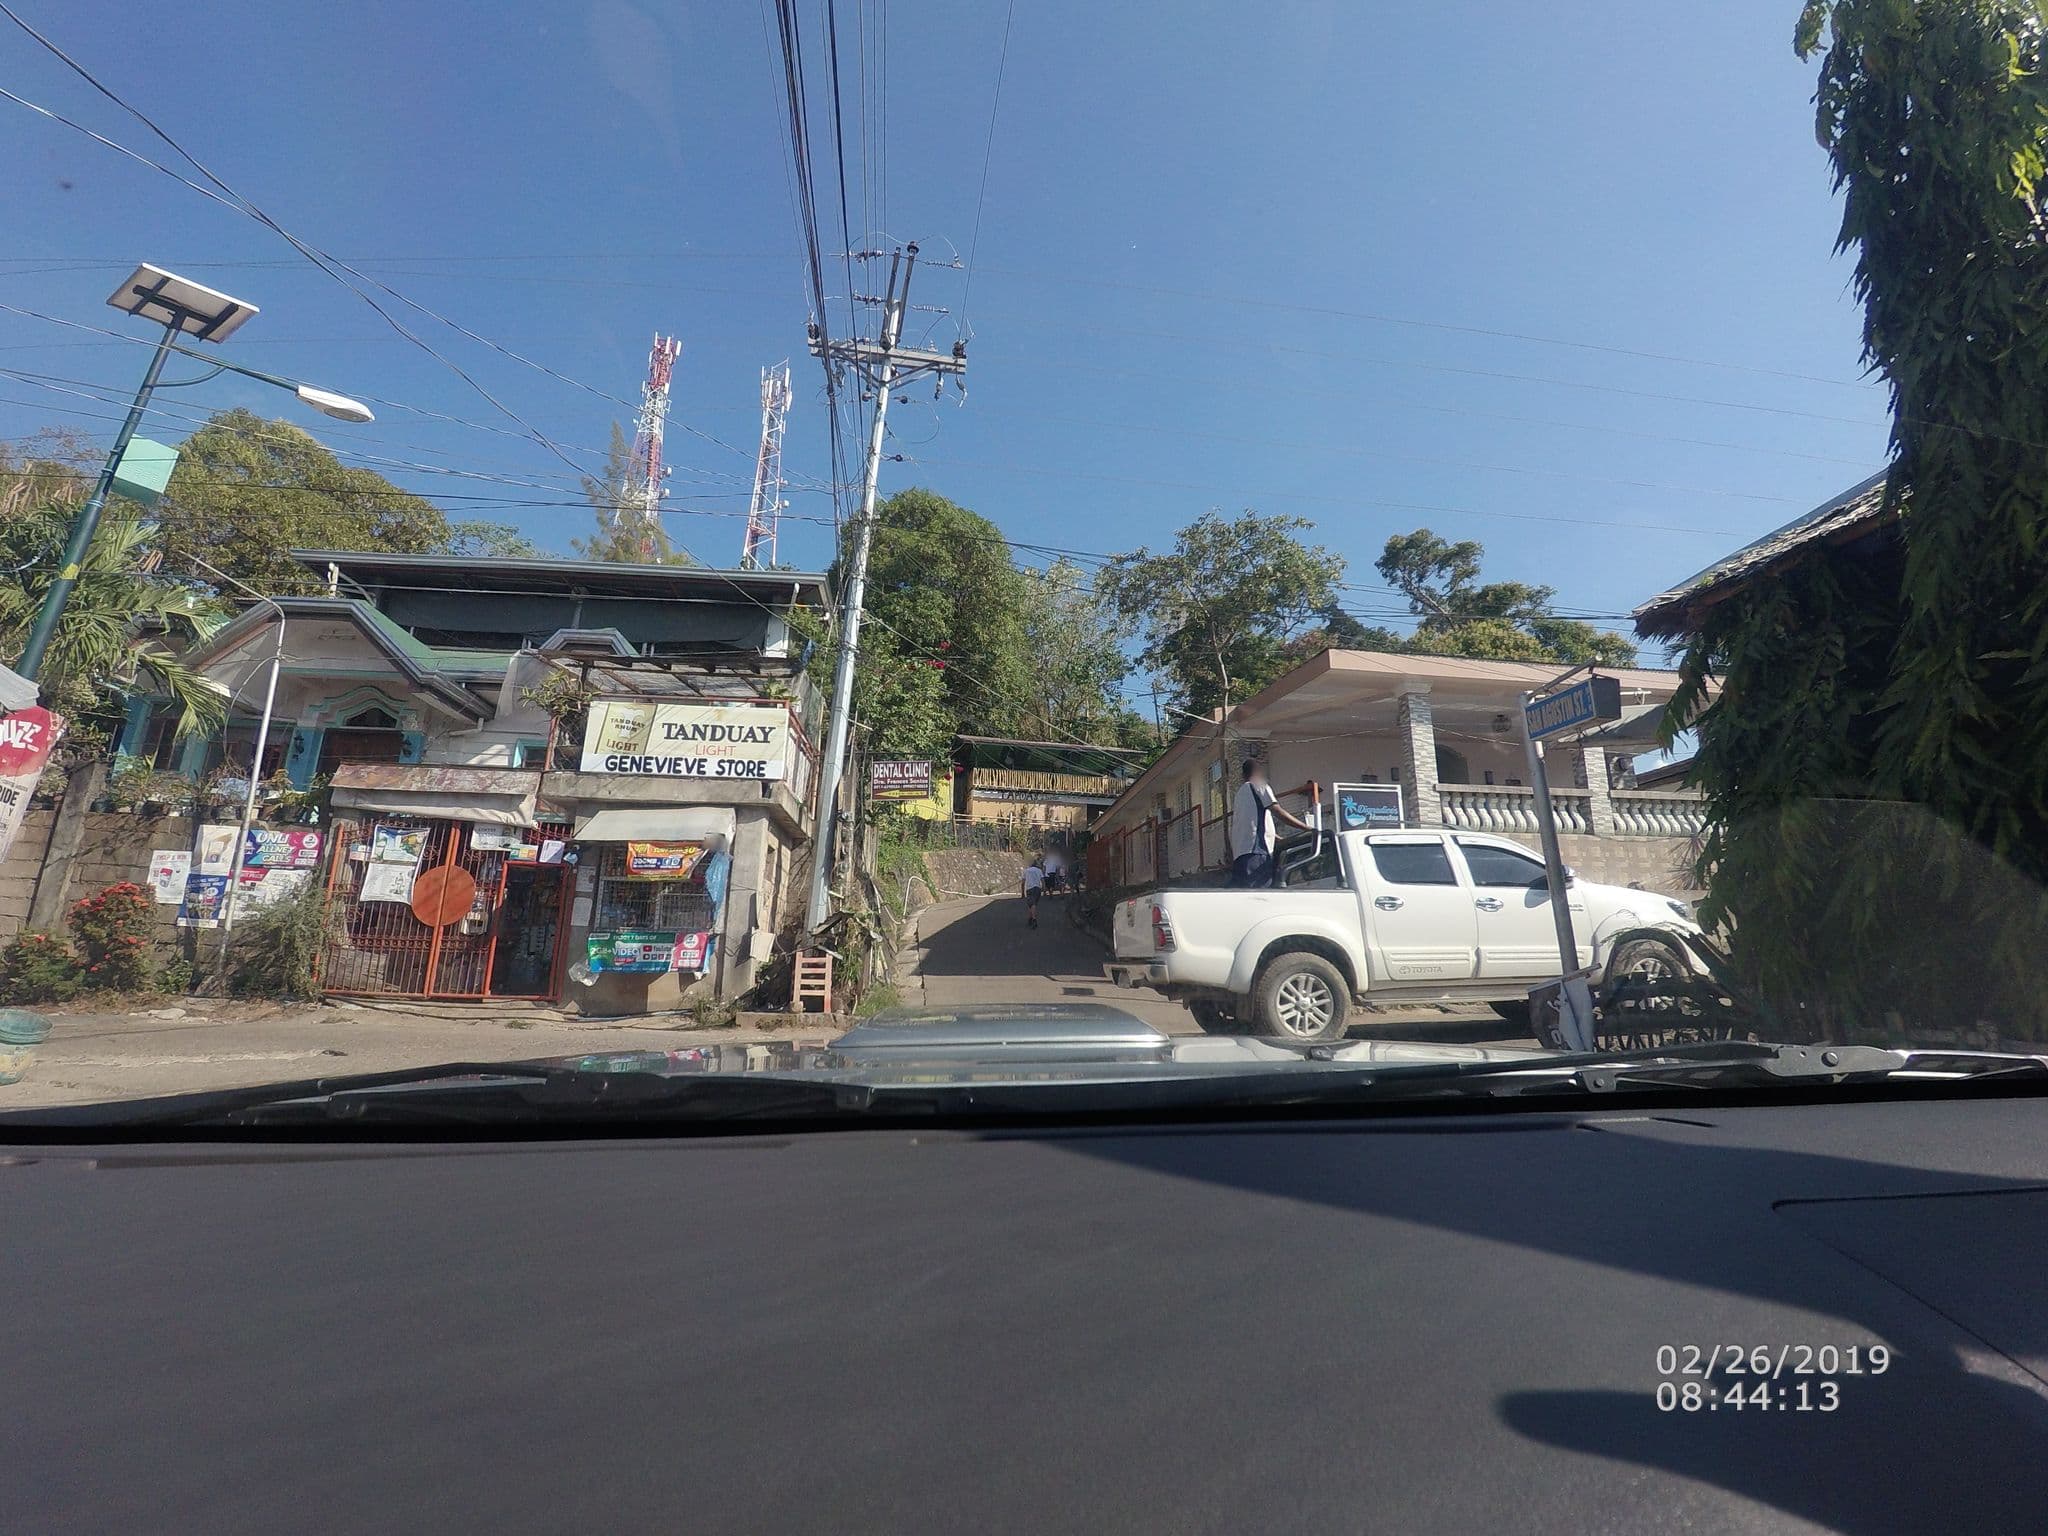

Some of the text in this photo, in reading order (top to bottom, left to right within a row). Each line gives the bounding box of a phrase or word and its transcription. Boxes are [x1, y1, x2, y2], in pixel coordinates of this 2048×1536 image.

[661, 722, 776, 744] TANDUAY
[606, 738, 640, 752] LIGHT
[695, 744, 737, 757] LIGHT
[604, 754, 768, 778] GENEVIEVE STORE
[873, 762, 929, 779] DENTAL CLINIC
[256, 832, 290, 844] UNLI
